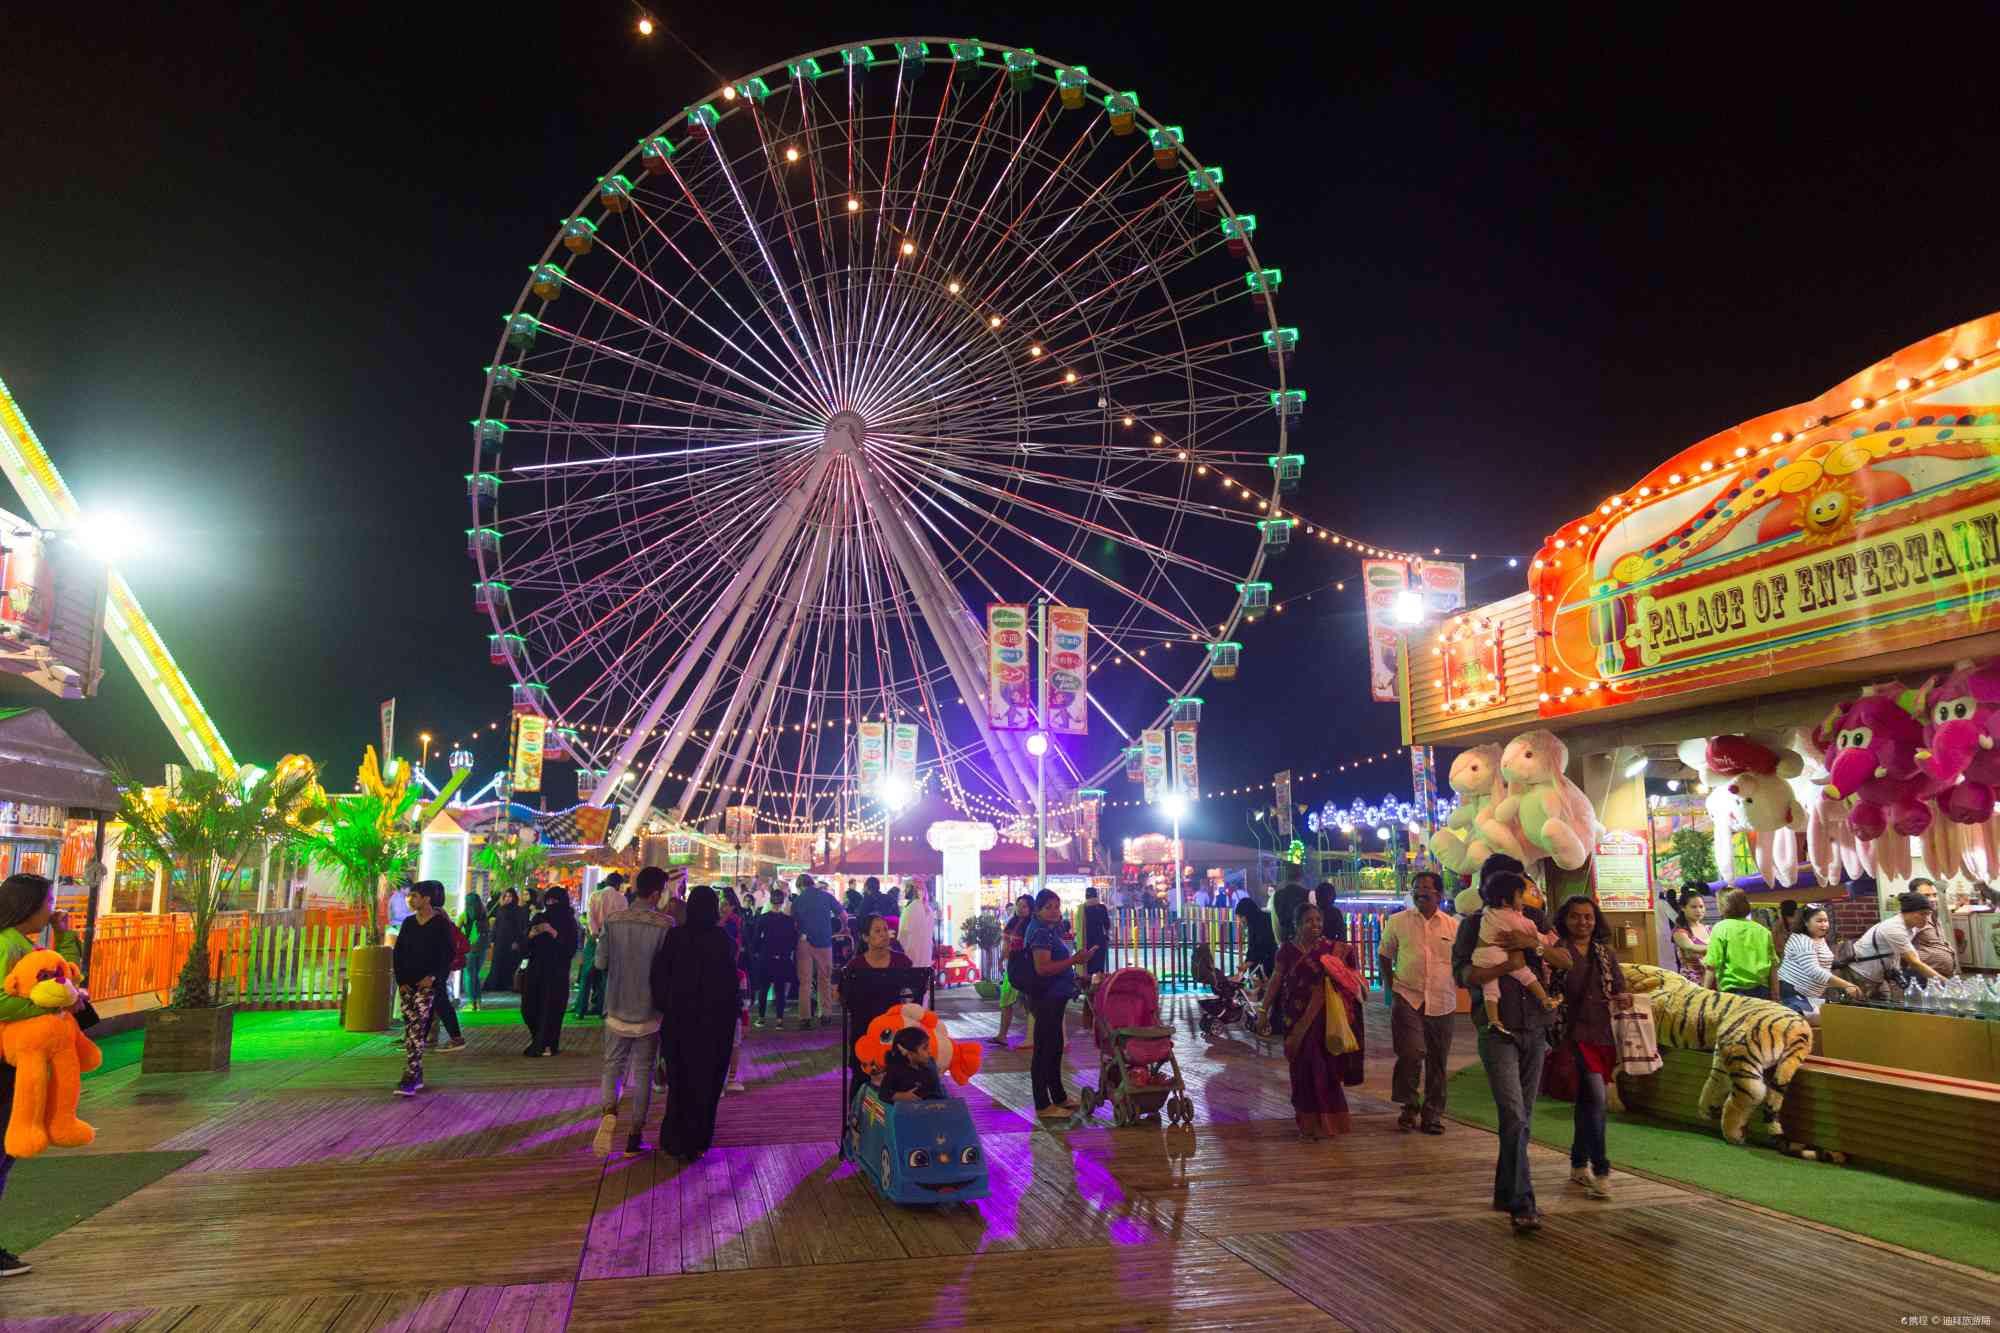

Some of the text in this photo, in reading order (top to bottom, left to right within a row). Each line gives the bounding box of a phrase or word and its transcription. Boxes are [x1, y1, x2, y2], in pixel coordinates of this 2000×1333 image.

[1648, 511, 2000, 650] PALACE OF ENTERTAIN
